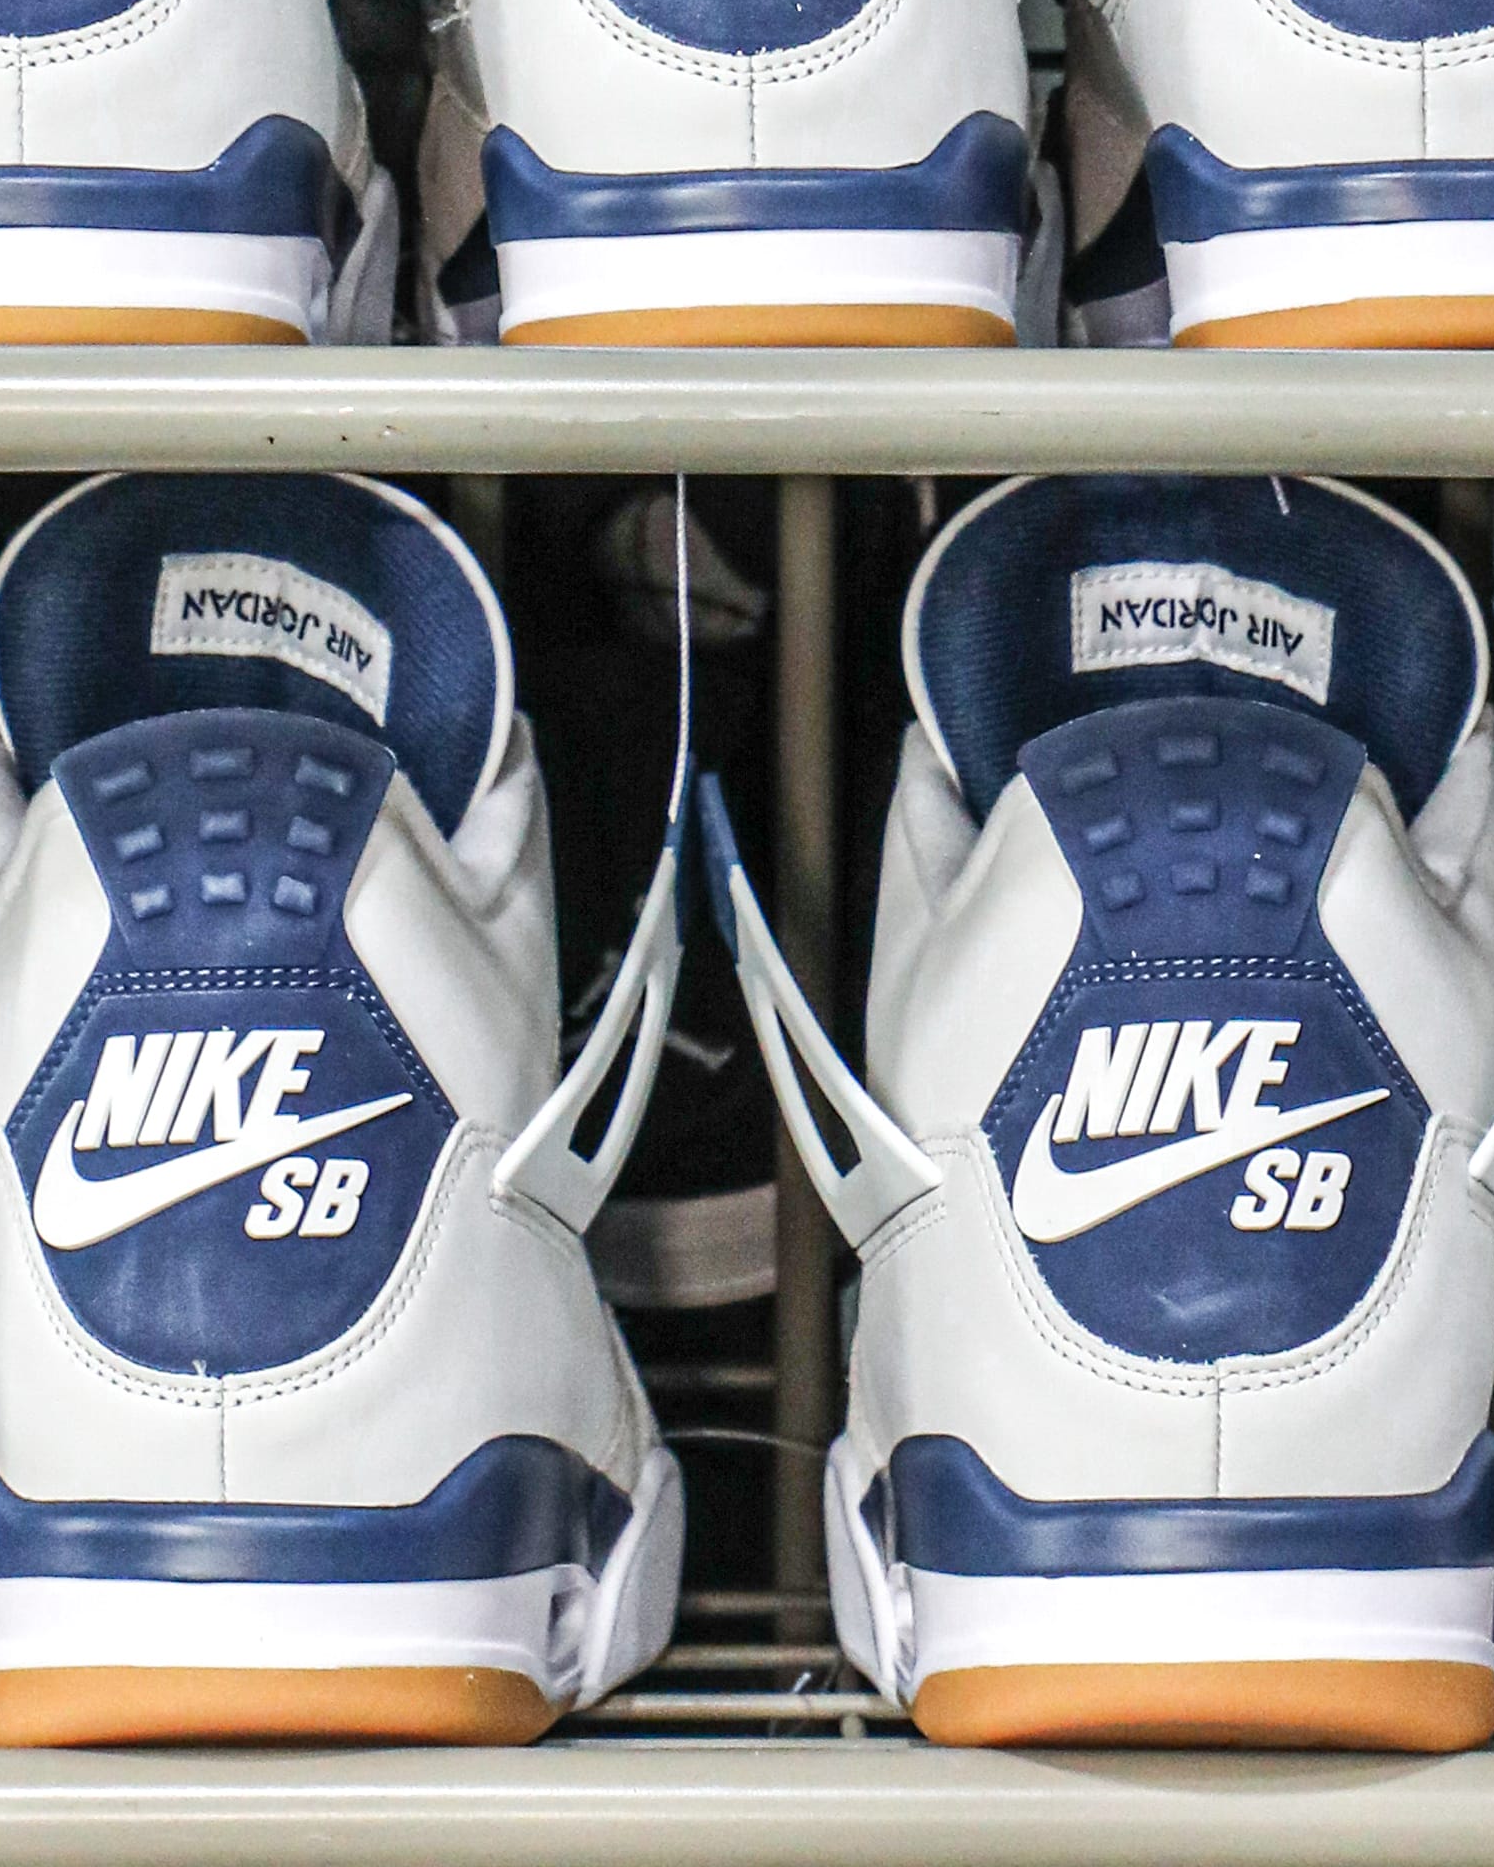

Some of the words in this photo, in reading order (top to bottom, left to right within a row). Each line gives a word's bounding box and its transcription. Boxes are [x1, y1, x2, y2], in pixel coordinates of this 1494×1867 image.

[181, 588, 320, 642] JORDAN
[326, 622, 373, 673] AIR
[1100, 597, 1238, 635] JORDAN
[1247, 613, 1304, 657] AIR
[75, 1024, 324, 1148] NIKE
[1053, 1021, 1302, 1143] NIKE
[242, 1154, 371, 1240] SB
[1227, 1145, 1354, 1232] SB
